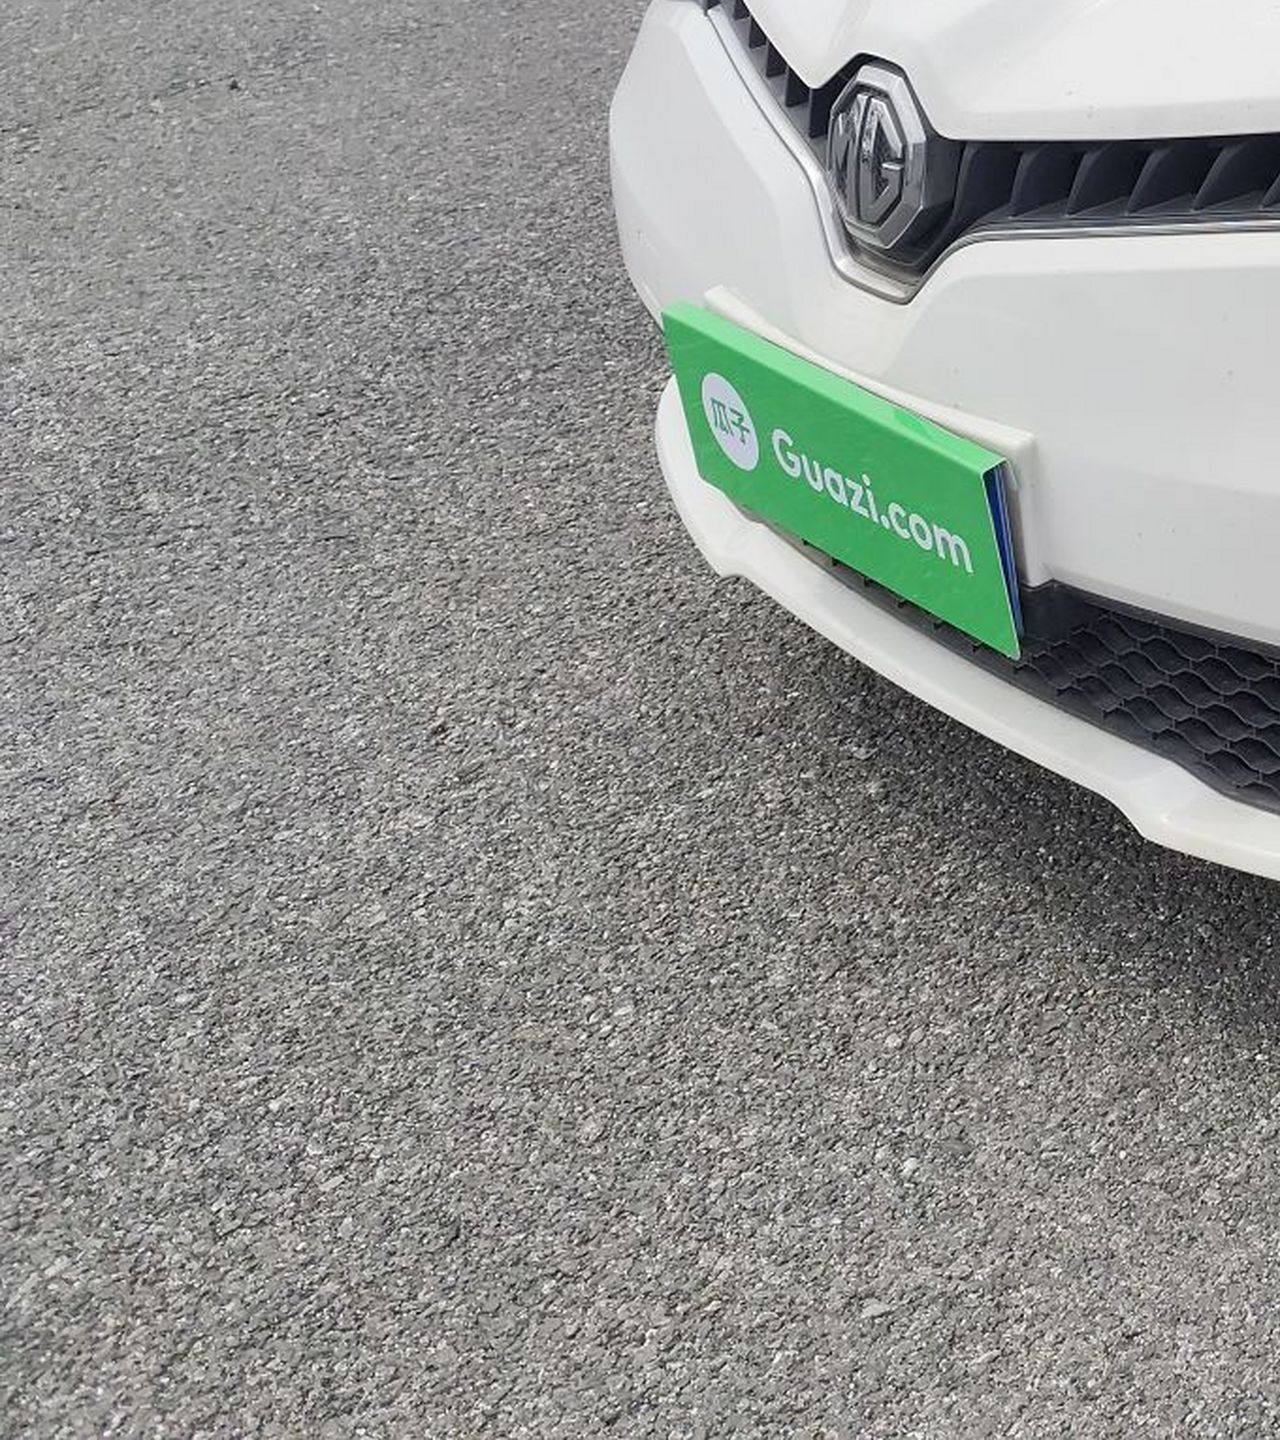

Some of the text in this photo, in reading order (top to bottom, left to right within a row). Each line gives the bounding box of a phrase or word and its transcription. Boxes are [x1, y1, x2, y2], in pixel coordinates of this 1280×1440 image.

[830, 93, 904, 224] MG
[711, 396, 751, 446] 瓜子
[771, 428, 974, 574] Guazi.com
